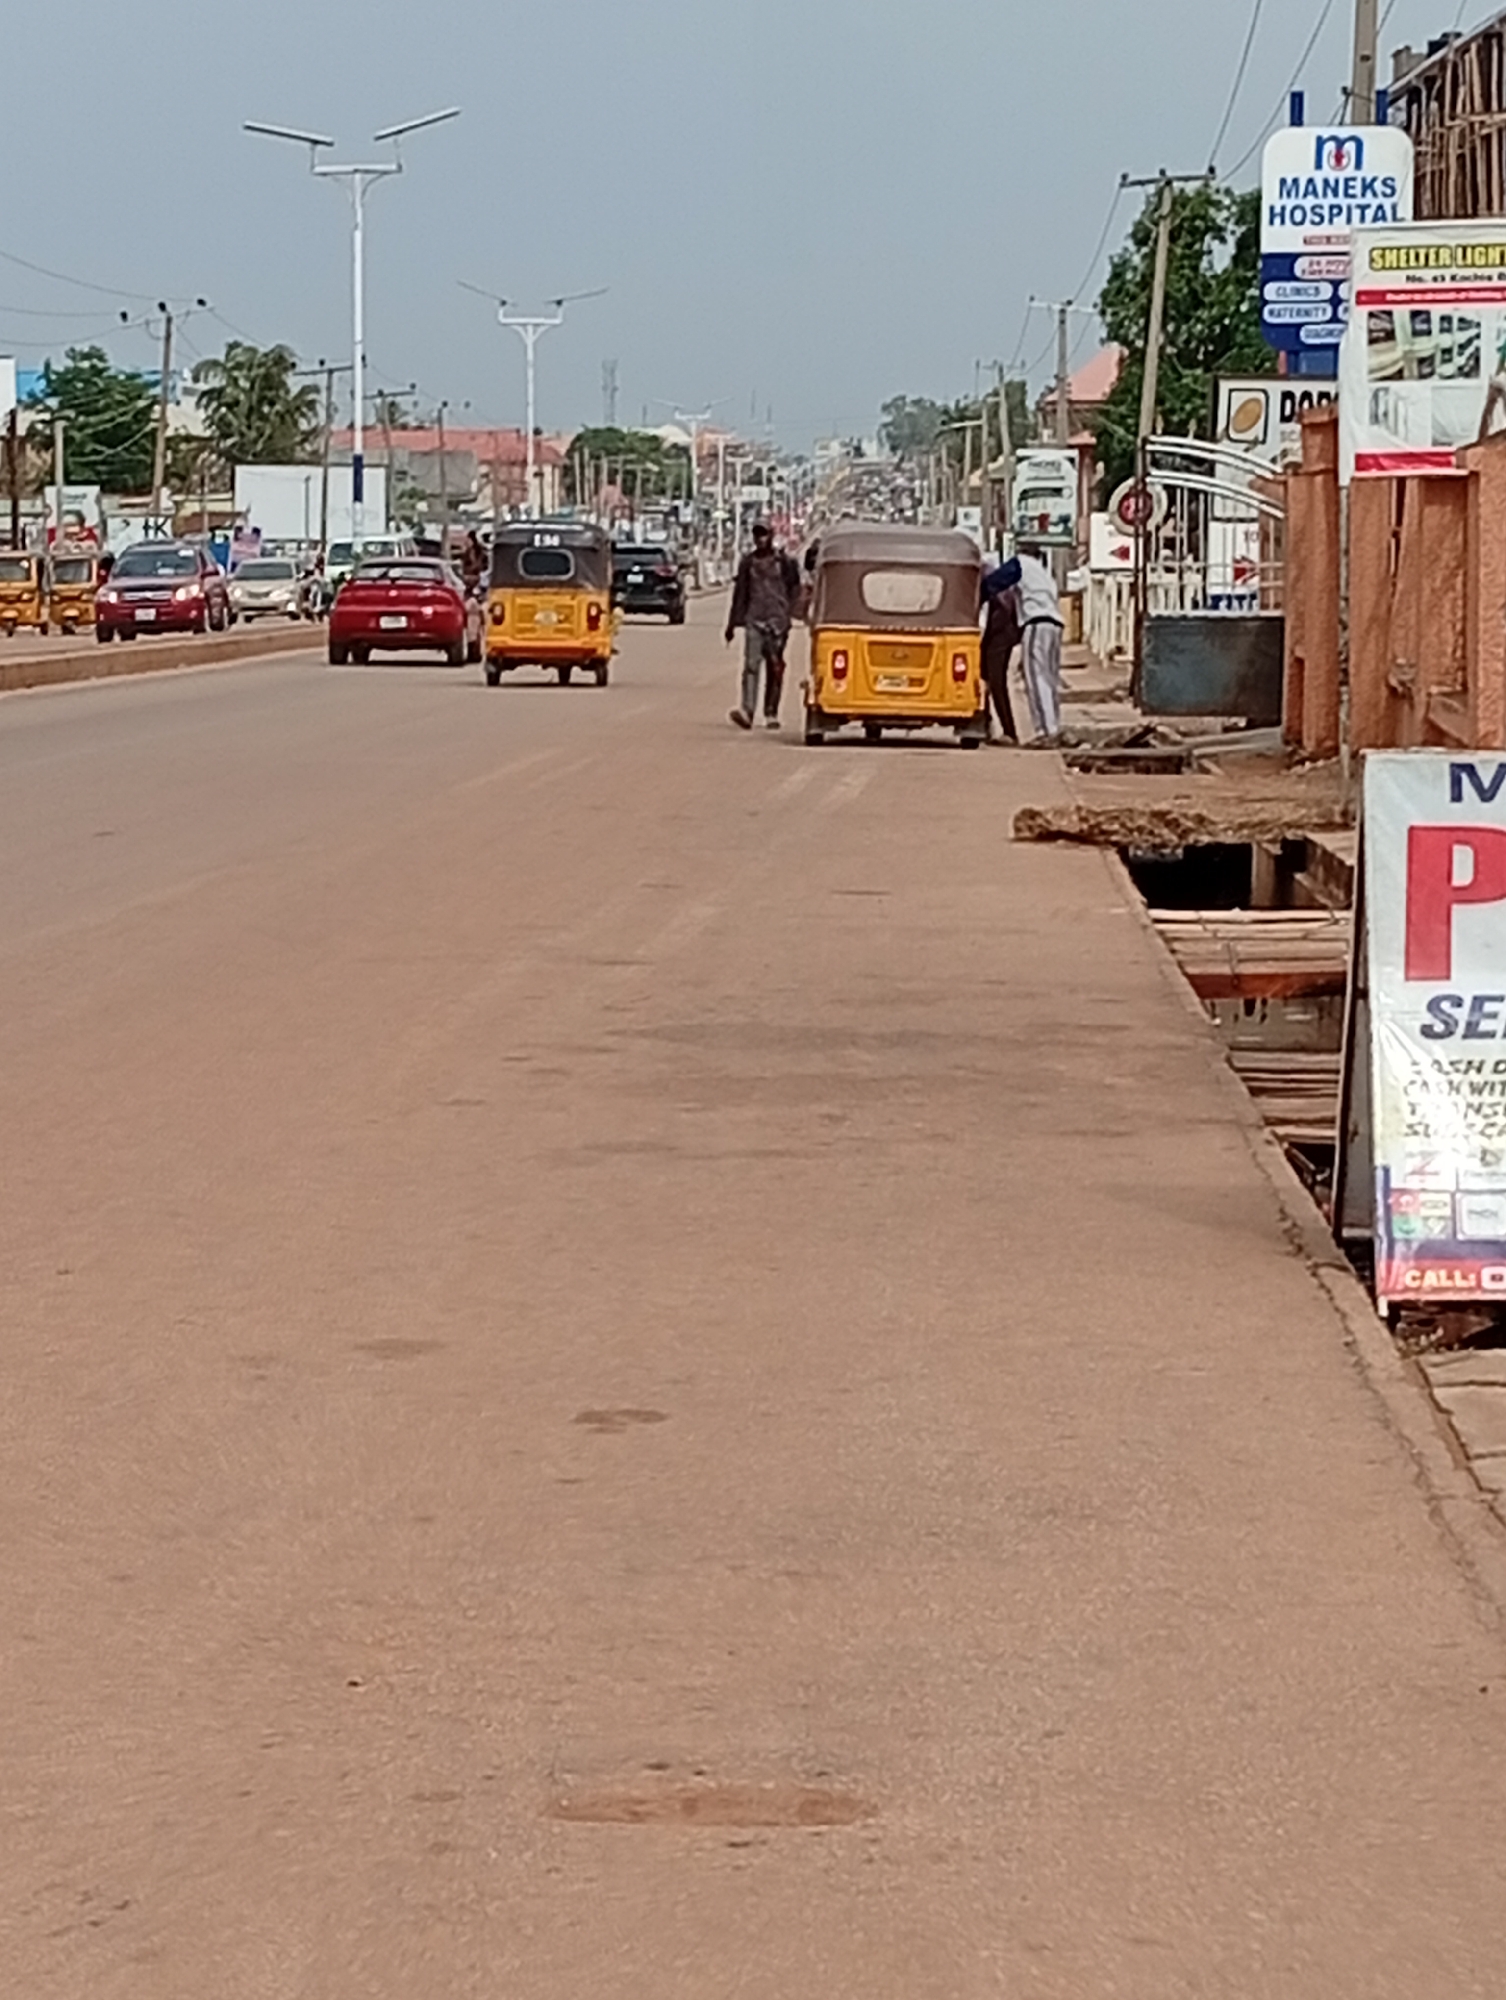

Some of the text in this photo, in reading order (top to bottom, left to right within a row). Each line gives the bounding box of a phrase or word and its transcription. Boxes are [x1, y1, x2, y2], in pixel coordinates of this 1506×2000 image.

[1278, 176, 1397, 200] MANEKS
[1268, 203, 1404, 226] HOSPITAL
[1370, 245, 1452, 271] SHELTER
[1275, 285, 1321, 298] CLINICS
[1267, 306, 1328, 319] MATERNITY
[1420, 993, 1506, 1040] SE
[1404, 1269, 1477, 1288] CALL:
